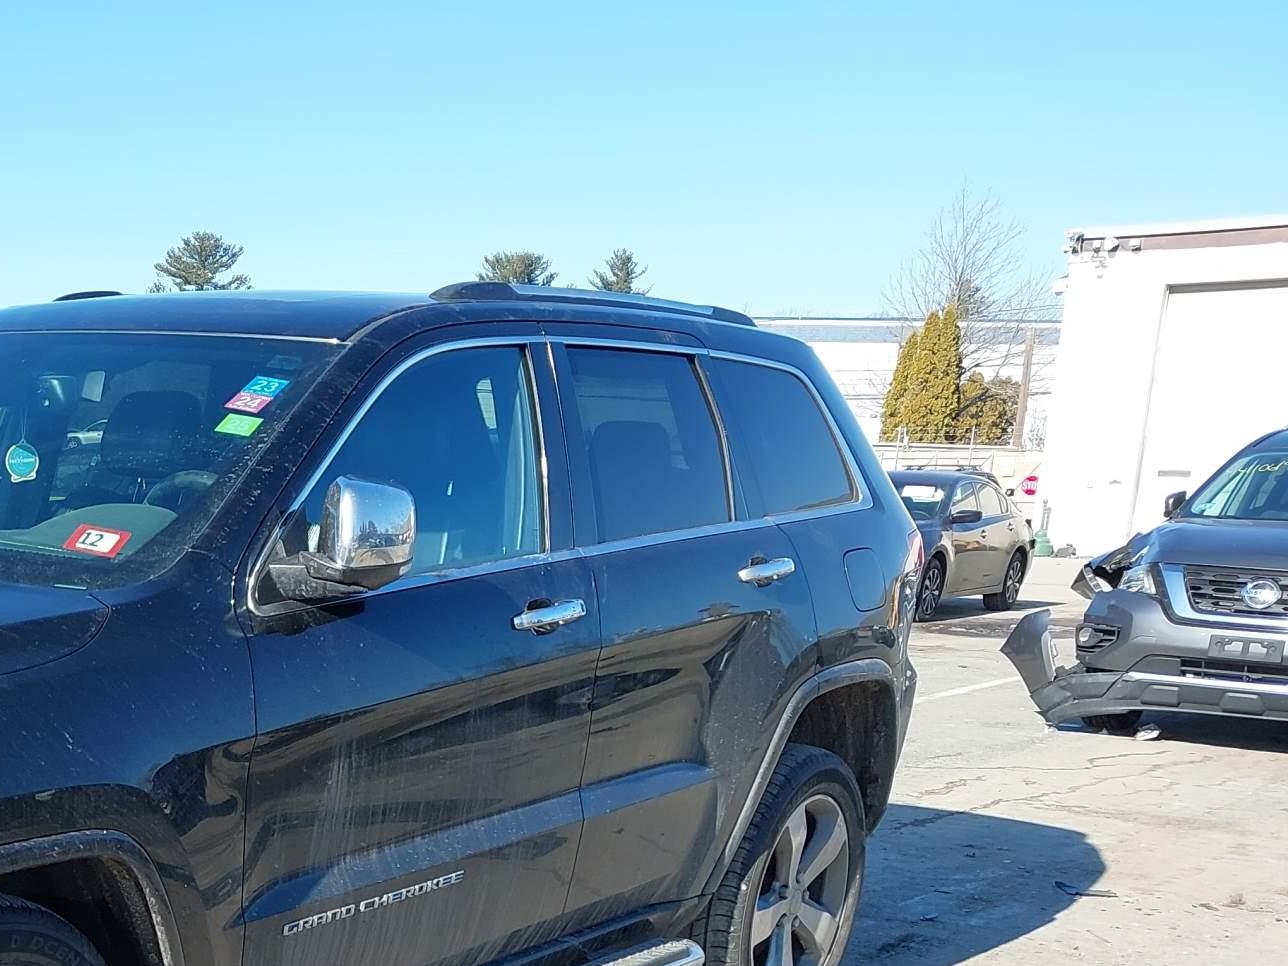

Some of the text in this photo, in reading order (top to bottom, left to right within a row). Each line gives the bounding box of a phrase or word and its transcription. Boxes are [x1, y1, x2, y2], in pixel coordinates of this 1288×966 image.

[251, 380, 280, 392] 23
[235, 396, 261, 408] 24
[78, 531, 105, 547] 12
[283, 870, 465, 936] GRAND CHEROKEE
